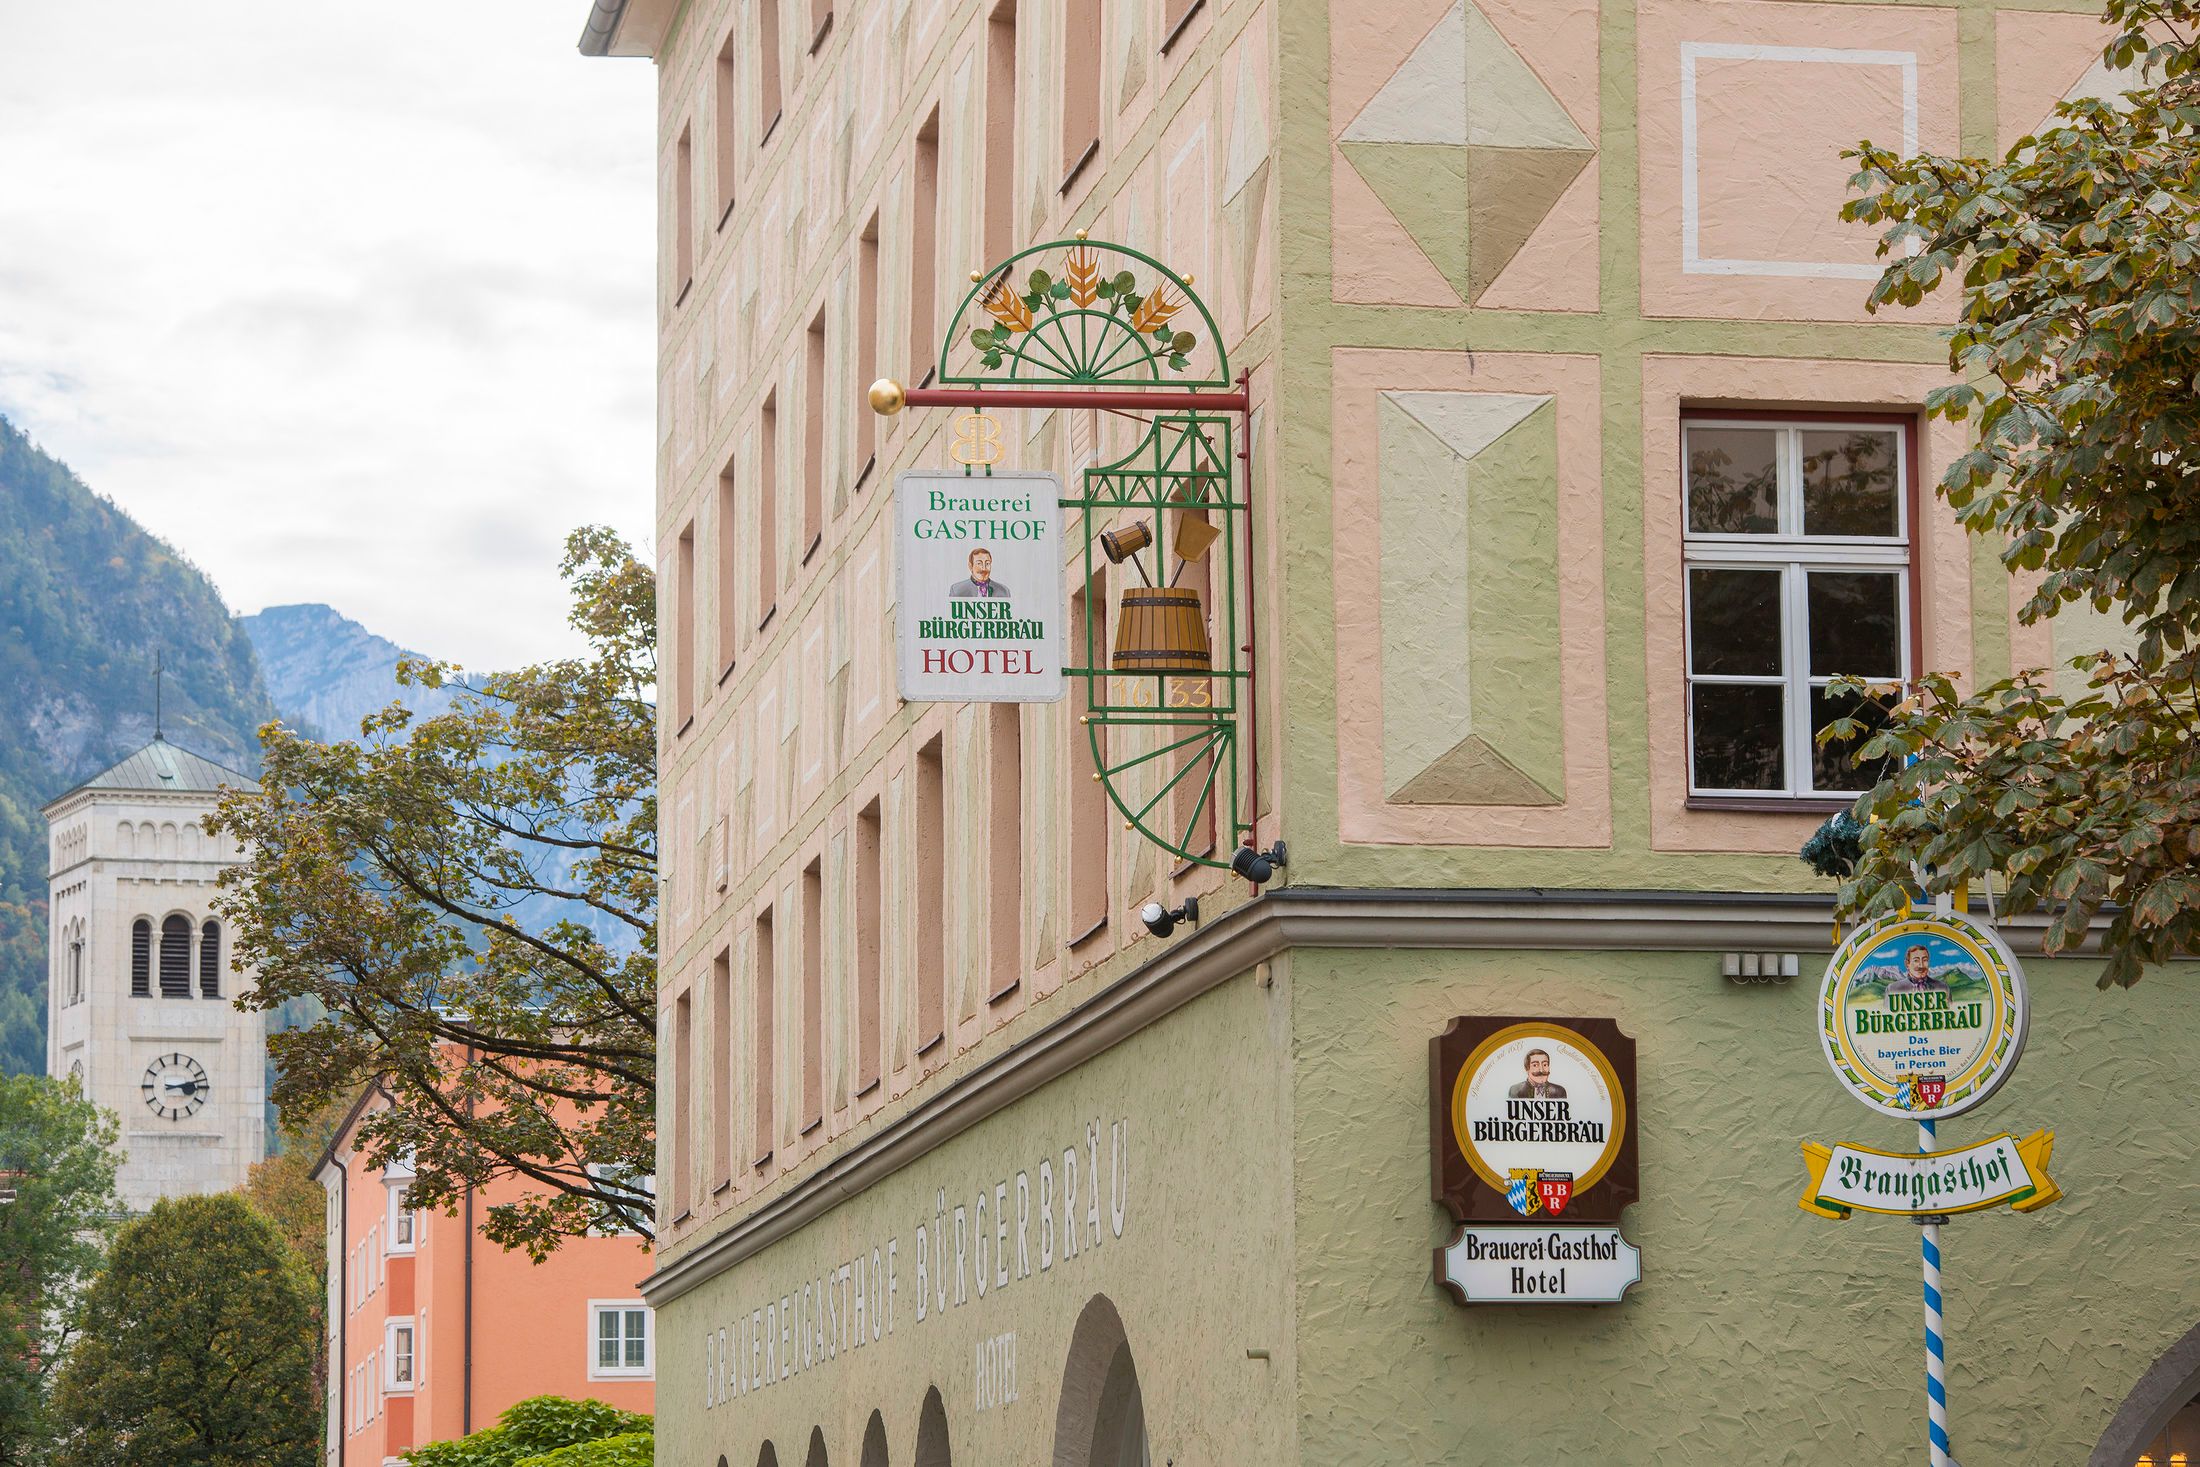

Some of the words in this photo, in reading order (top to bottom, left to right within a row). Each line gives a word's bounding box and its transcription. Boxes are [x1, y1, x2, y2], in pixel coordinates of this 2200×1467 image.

[928, 490, 1033, 513] Brauerei
[913, 519, 1047, 541] GASTHOF
[950, 601, 1012, 620] UNSER
[918, 617, 1044, 641] BÜRGERBRÄU
[922, 649, 1043, 676] HOTEL
[1888, 990, 1948, 1013] UNSER
[1855, 1002, 1982, 1034] BÜRGERBRÄU
[1908, 1036, 1928, 1046] Das
[1878, 1048, 1935, 1060] bayerische
[1939, 1046, 1961, 1056] Bier
[1895, 1060, 1905, 1070] in
[1909, 1060, 1946, 1069] Person
[1506, 1100, 1571, 1121] UNSER
[1473, 1117, 1605, 1144] BÜRGERBRÄU
[1838, 1147, 2013, 1208] Braugasthof
[707, 1238, 898, 1410] BRAUEREIGASTHOF
[916, 1117, 1129, 1323] BÜRGERBRÄU
[1511, 1267, 1566, 1294] Hotel
[976, 1331, 1019, 1413] HOTEL
